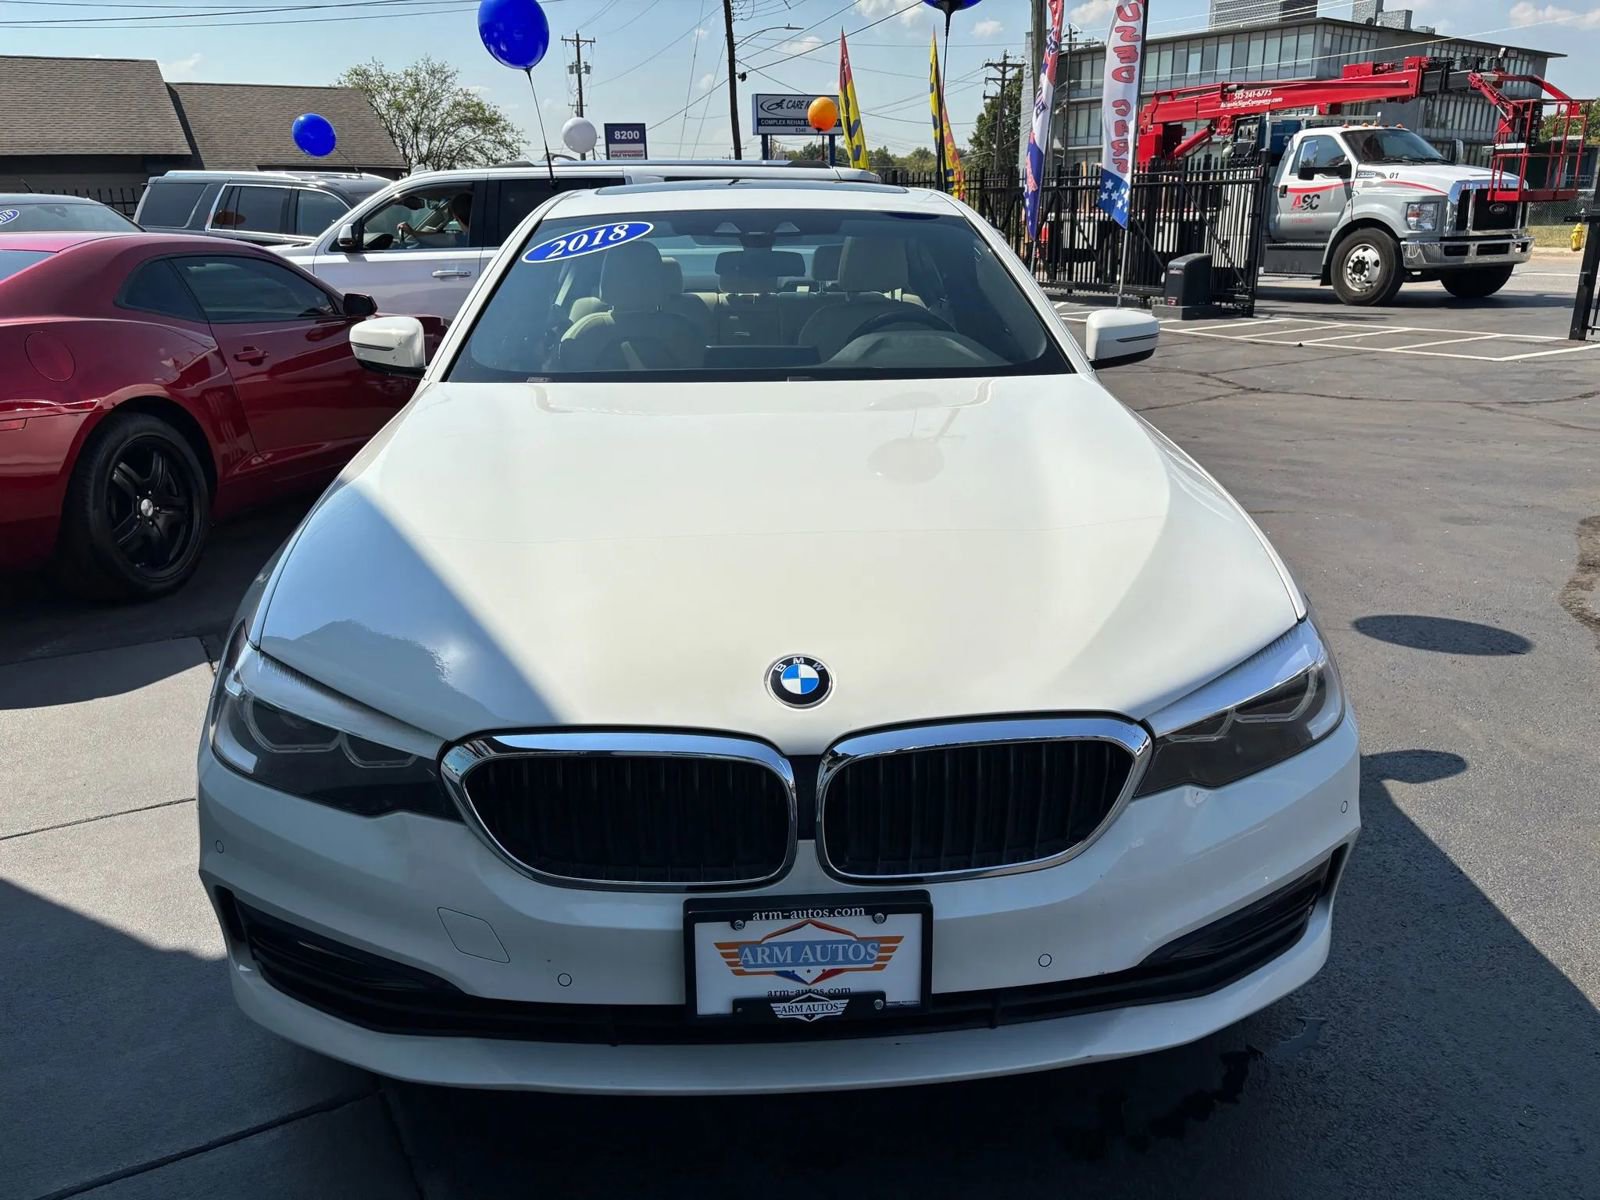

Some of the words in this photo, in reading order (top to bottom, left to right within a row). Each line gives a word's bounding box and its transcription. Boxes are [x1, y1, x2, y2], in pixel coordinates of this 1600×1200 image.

[1234, 88, 1273, 100] 513-241-6775
[787, 99, 805, 110] CARE
[614, 130, 640, 140] 8200
[1292, 193, 1321, 211] ASC
[545, 224, 630, 260] 2018
[775, 656, 825, 673] BMW
[752, 906, 865, 921] arm-autos.com
[739, 946, 792, 965] ARM
[800, 942, 879, 964] AUTOS
[780, 1003, 804, 1014] ARM
[805, 1002, 840, 1013] AUTOS
